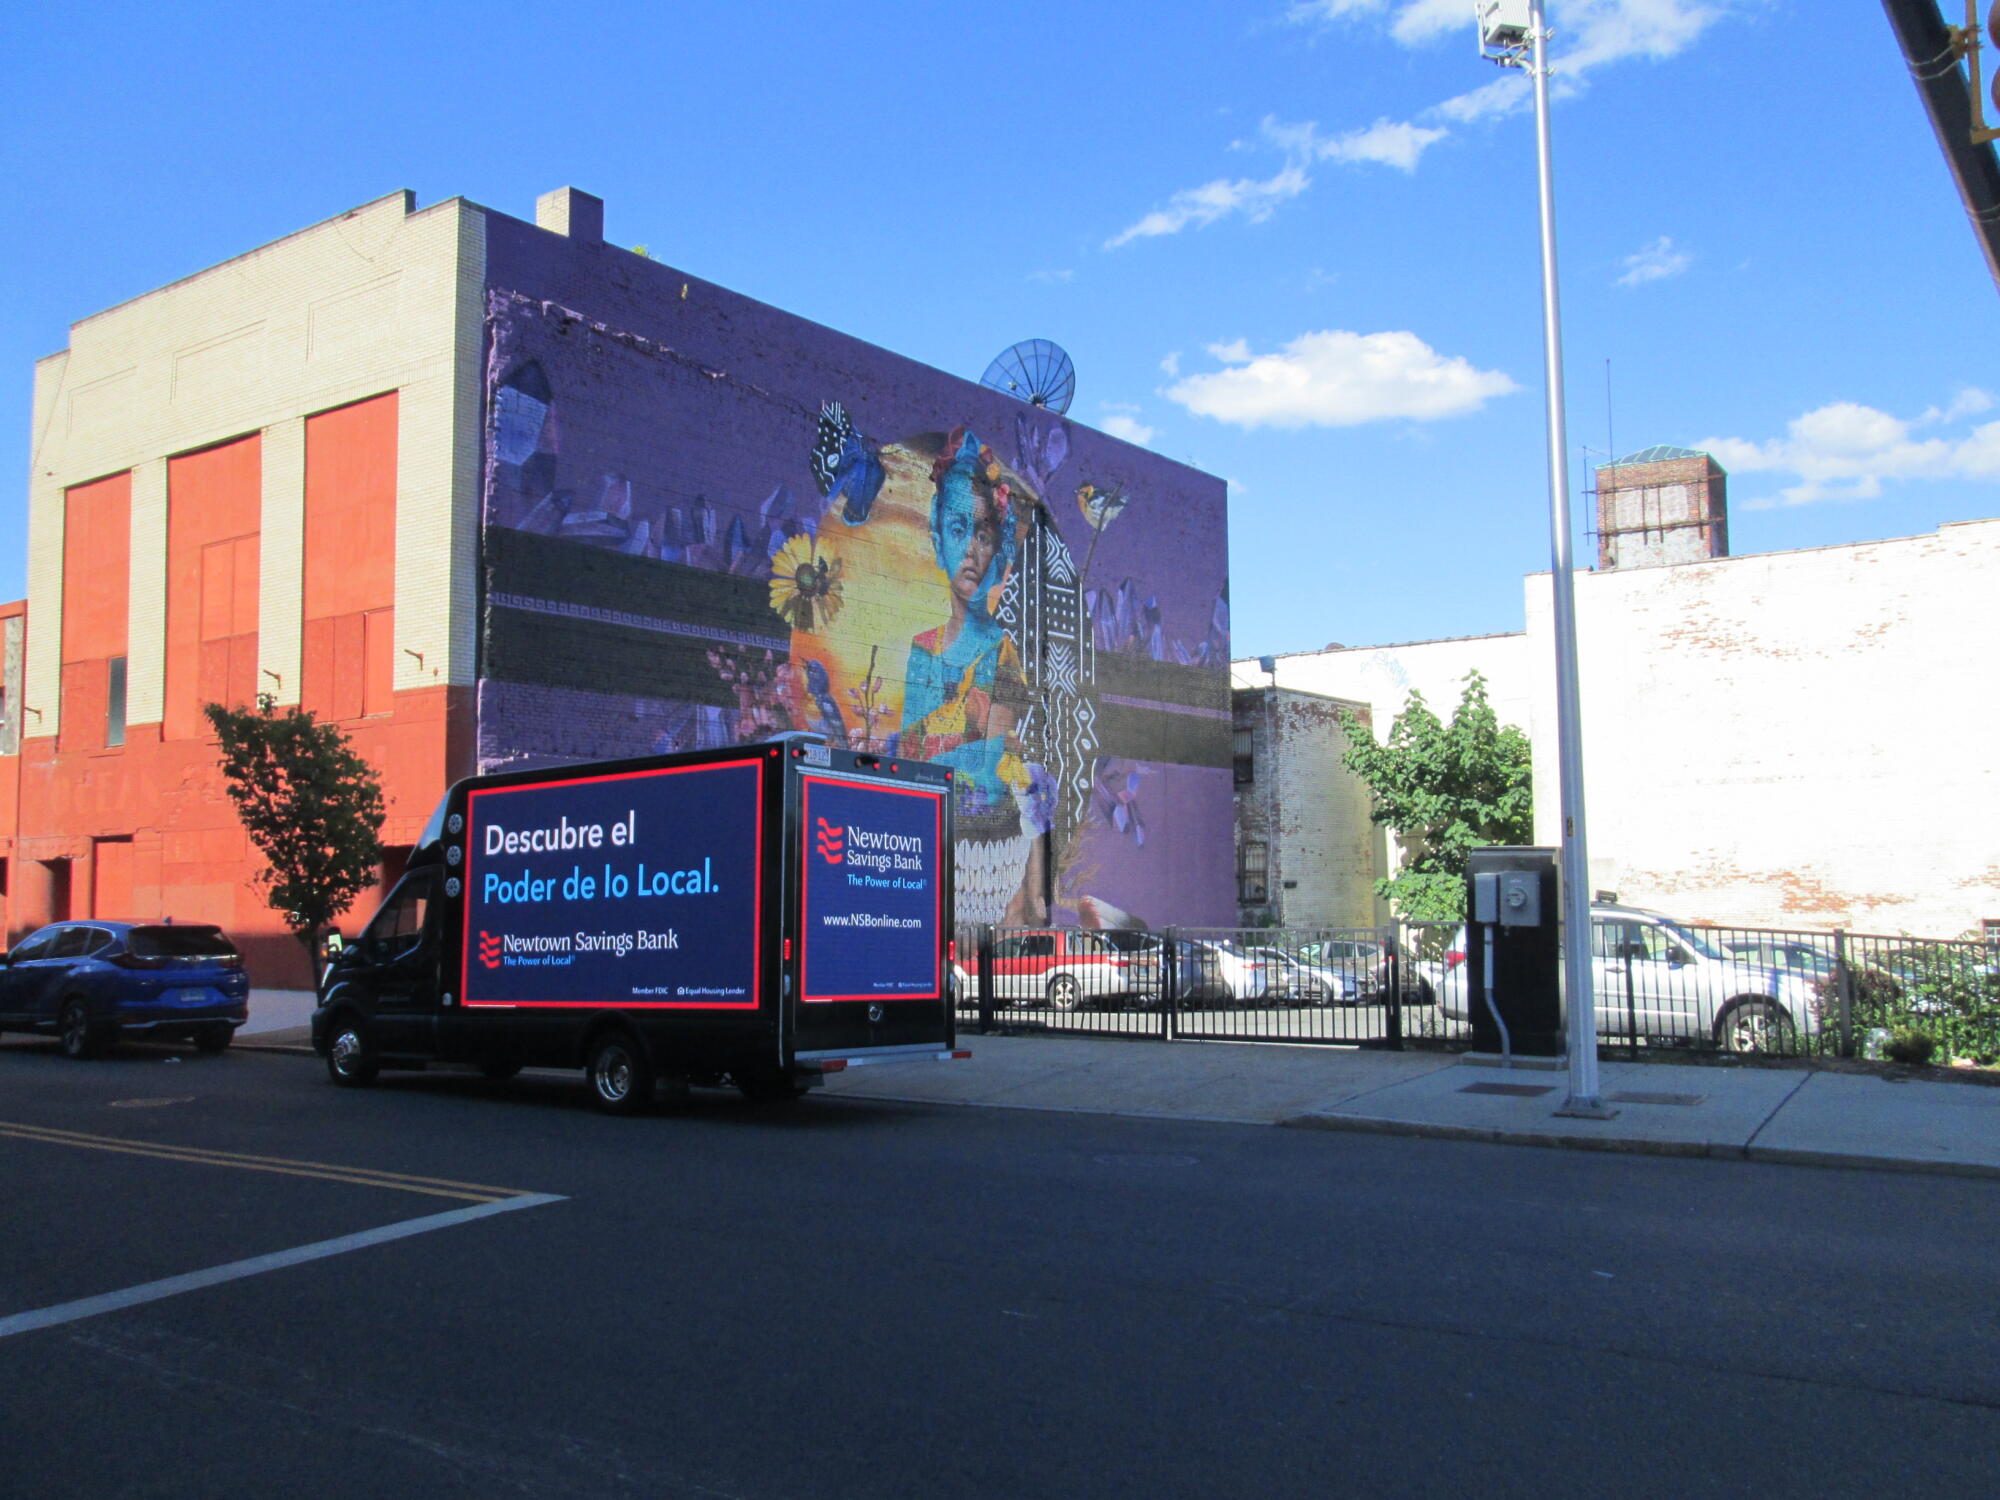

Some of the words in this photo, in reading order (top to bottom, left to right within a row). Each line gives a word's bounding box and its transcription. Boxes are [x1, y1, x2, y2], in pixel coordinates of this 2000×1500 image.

[486, 816, 603, 855] Descubre
[612, 810, 635, 845] el
[848, 826, 922, 852] Newtown
[847, 850, 892, 872] Savings
[894, 853, 922, 870] Bank
[484, 869, 556, 904] Poder
[562, 866, 596, 900] de
[605, 864, 629, 898] lo
[638, 857, 719, 897] Local.
[847, 874, 863, 886] The
[865, 875, 891, 888] Power
[893, 877, 902, 889] of
[823, 913, 922, 928] www.NSBonline.com
[504, 933, 571, 953] Newtown
[575, 931, 633, 957] Savings
[637, 928, 679, 950] Bank
[503, 955, 516, 966] The
[518, 955, 541, 966] Power
[542, 954, 550, 965] of
[632, 986, 654, 995] Member
[655, 986, 669, 995] FDIC
[685, 986, 702, 996] Equal
[702, 986, 725, 997] Housing
[725, 986, 746, 995] Lender
